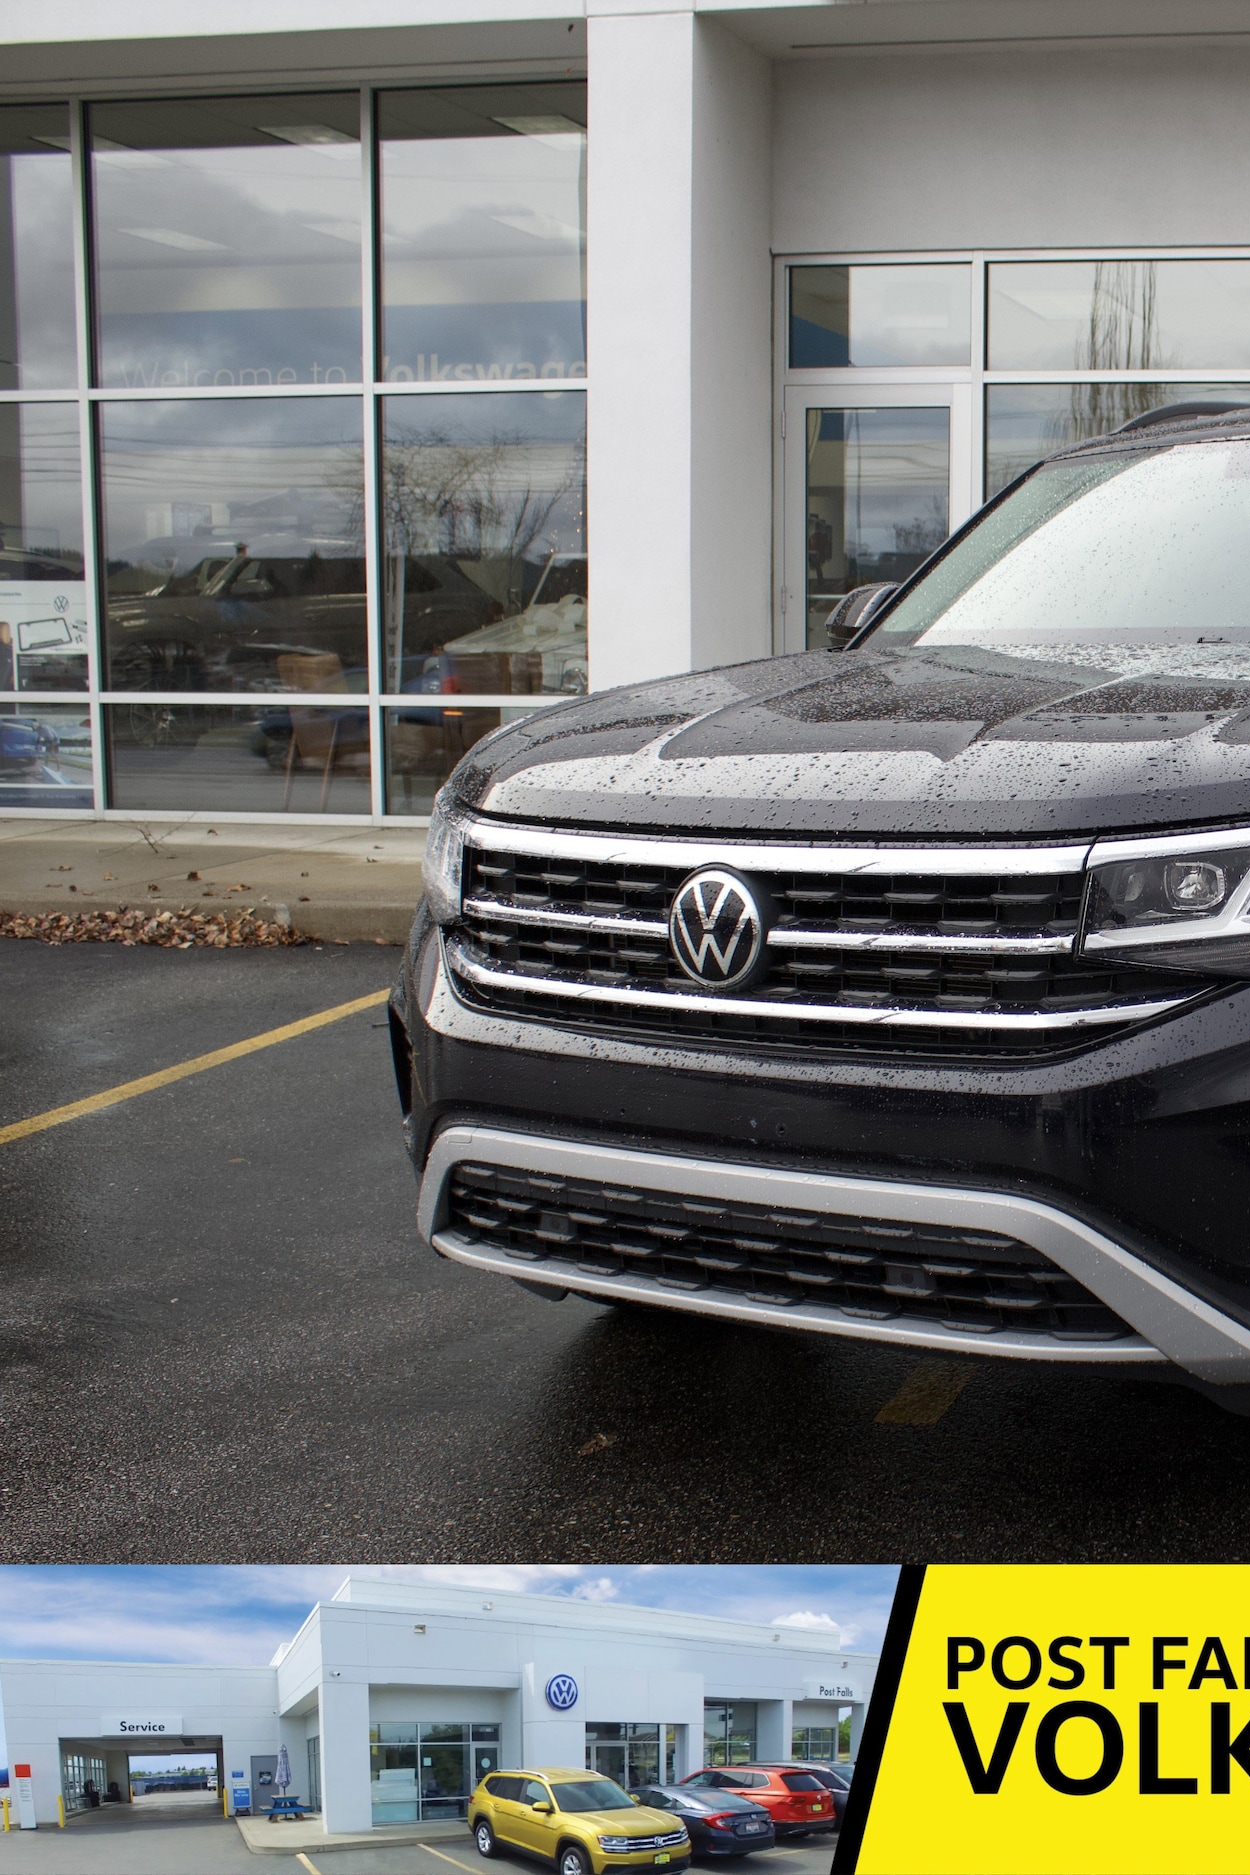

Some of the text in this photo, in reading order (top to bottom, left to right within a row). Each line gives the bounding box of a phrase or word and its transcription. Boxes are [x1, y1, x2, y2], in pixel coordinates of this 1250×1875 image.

[120, 360, 297, 388] Welcome
[310, 361, 347, 385] to
[670, 868, 760, 988] VW
[819, 1686, 854, 1697] Post Falls
[119, 1720, 166, 1732] Service
